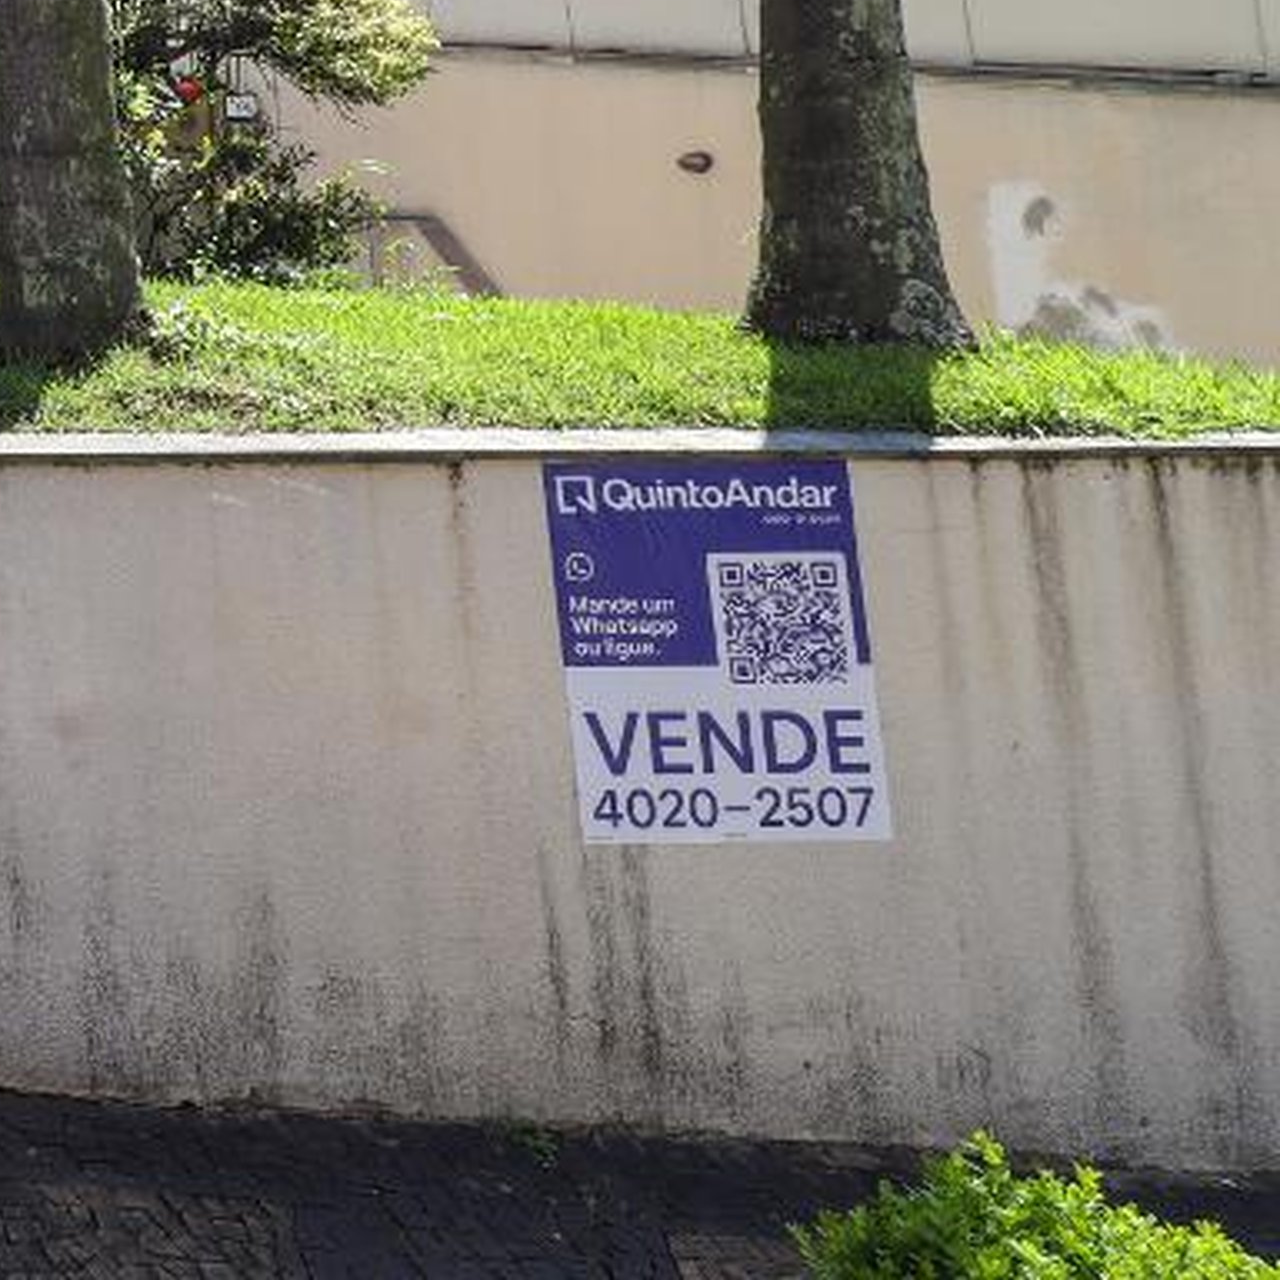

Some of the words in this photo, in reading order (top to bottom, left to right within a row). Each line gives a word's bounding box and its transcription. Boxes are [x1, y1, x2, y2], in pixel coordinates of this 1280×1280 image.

[603, 478, 838, 510] QuintoAndar
[583, 710, 871, 776] VENDE
[593, 786, 874, 829] 4020-2507
